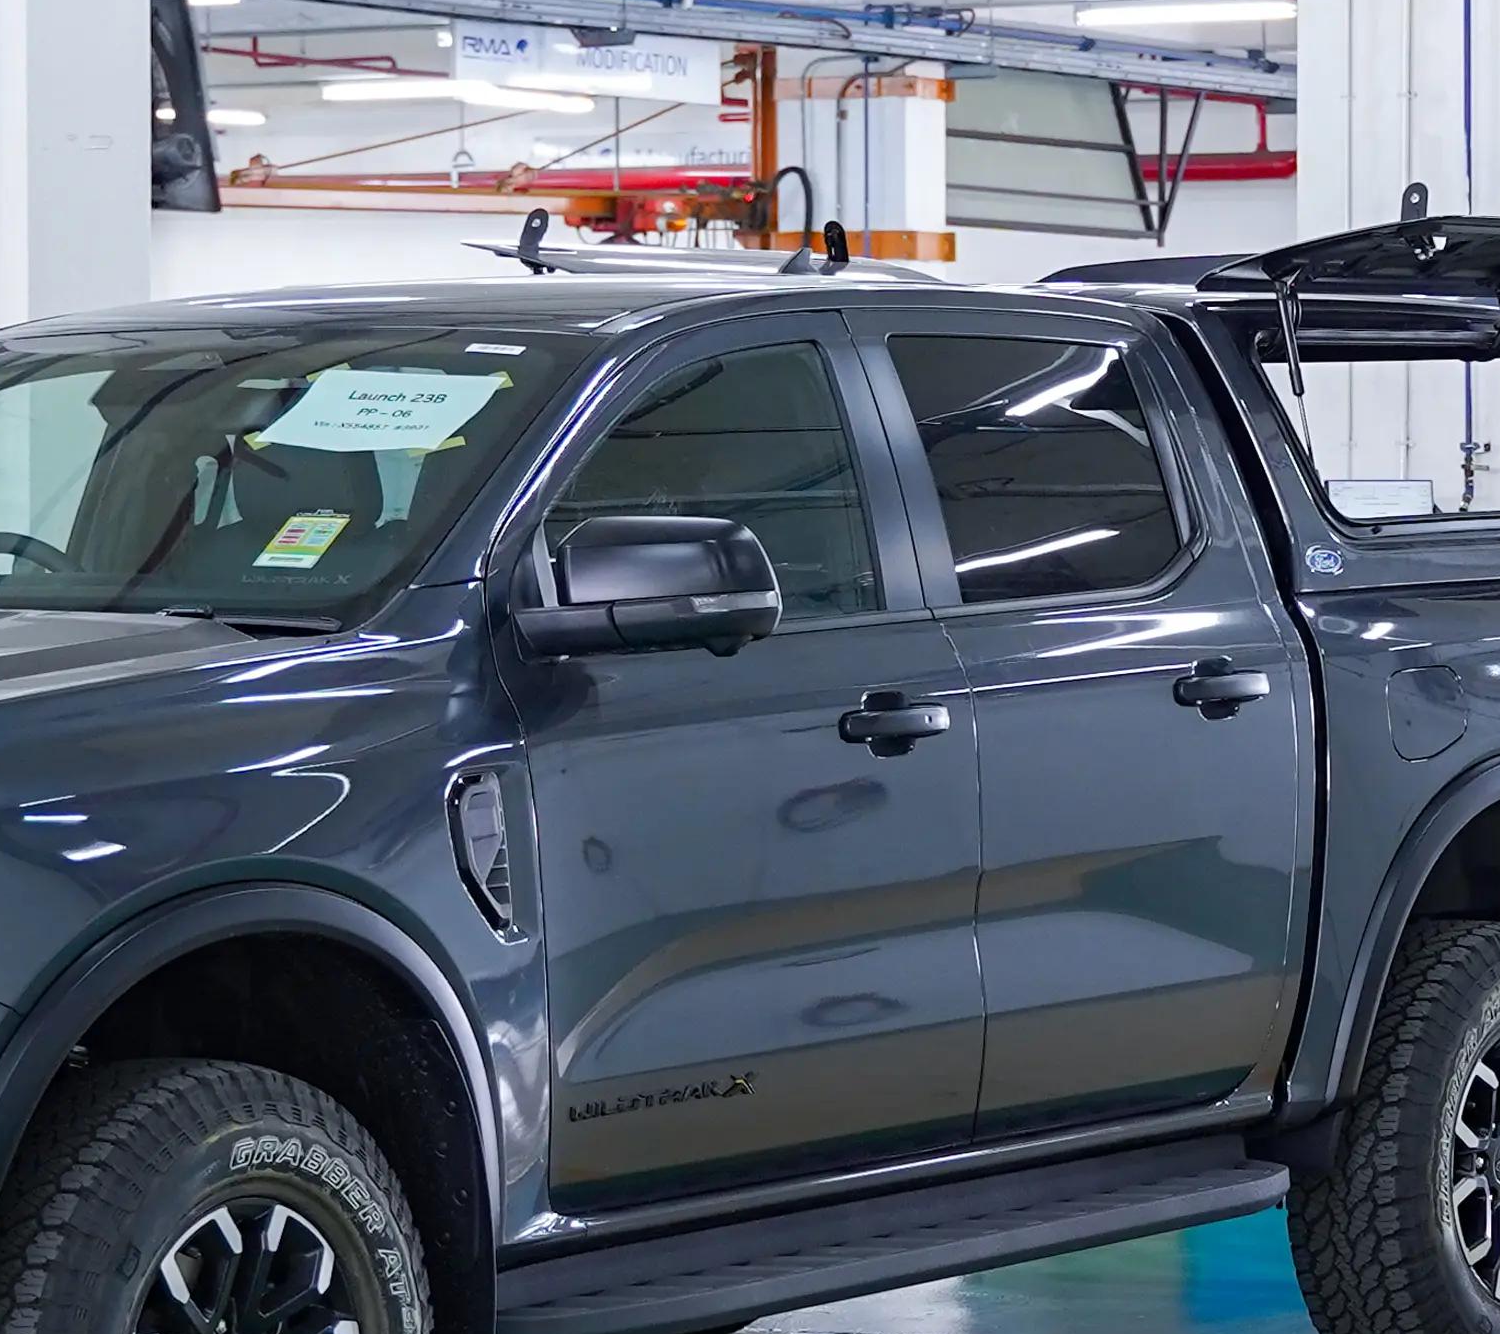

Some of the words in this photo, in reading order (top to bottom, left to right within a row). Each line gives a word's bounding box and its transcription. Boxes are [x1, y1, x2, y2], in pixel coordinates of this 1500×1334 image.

[462, 35, 511, 56] RMA
[576, 46, 688, 77] MODIFICATION
[348, 389, 407, 403] Launch
[409, 393, 449, 405] 23B
[356, 407, 379, 418] PP
[391, 408, 413, 419] 06
[229, 1134, 388, 1235] GRABBER
